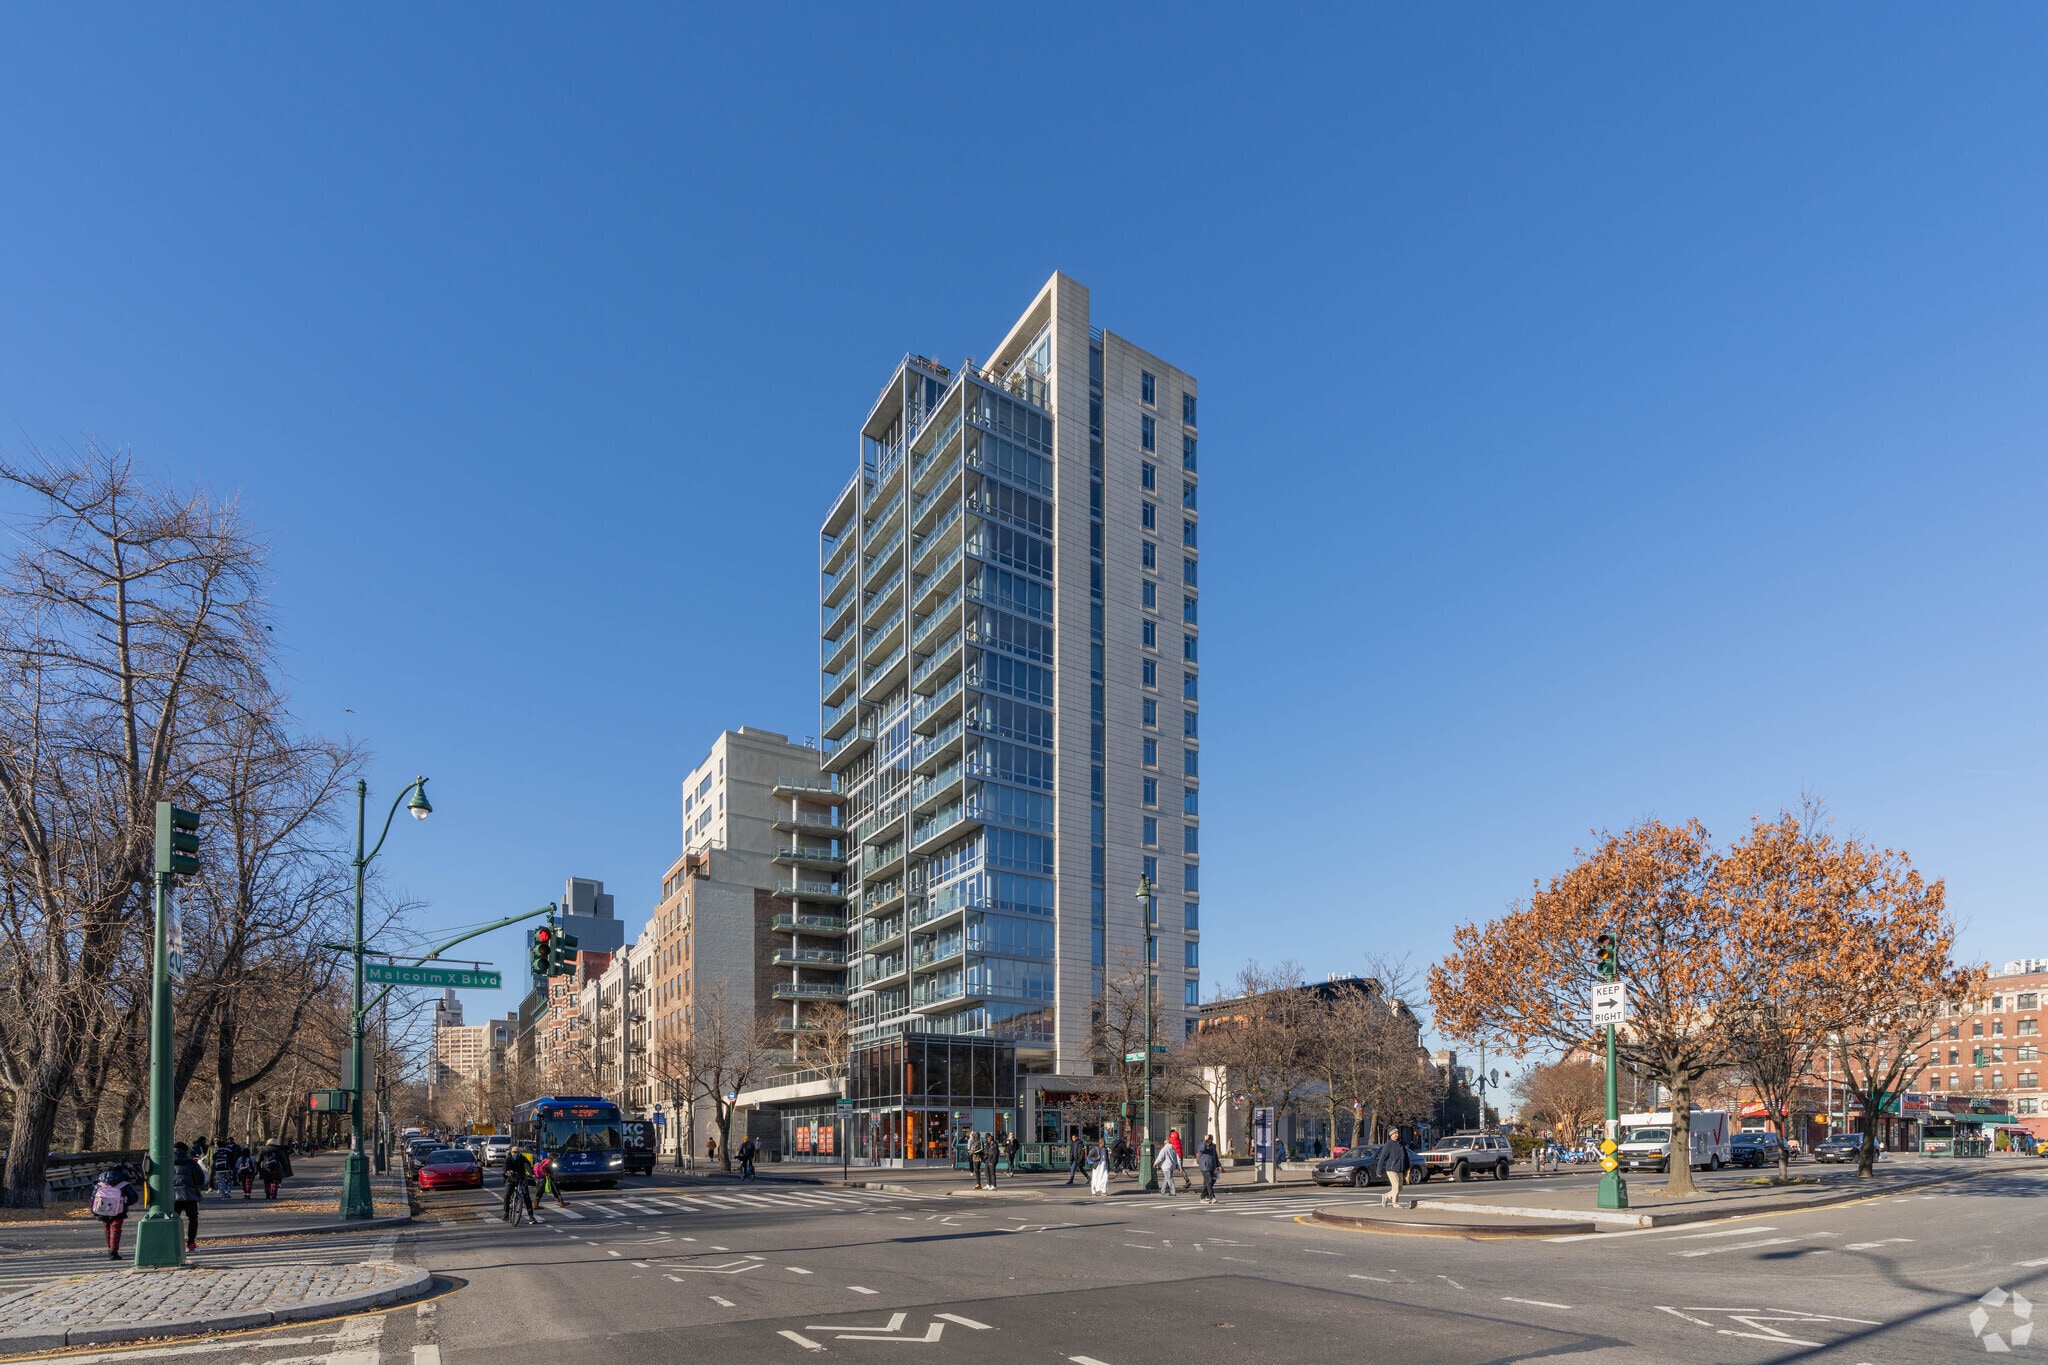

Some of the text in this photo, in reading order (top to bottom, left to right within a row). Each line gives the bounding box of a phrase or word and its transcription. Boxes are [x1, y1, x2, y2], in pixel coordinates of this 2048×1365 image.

[369, 968, 497, 985] Malcolm X Blvd
[1596, 985, 1620, 996] KEEP
[1595, 1011, 1621, 1022] RIGHT
[622, 1122, 644, 1135] KC
